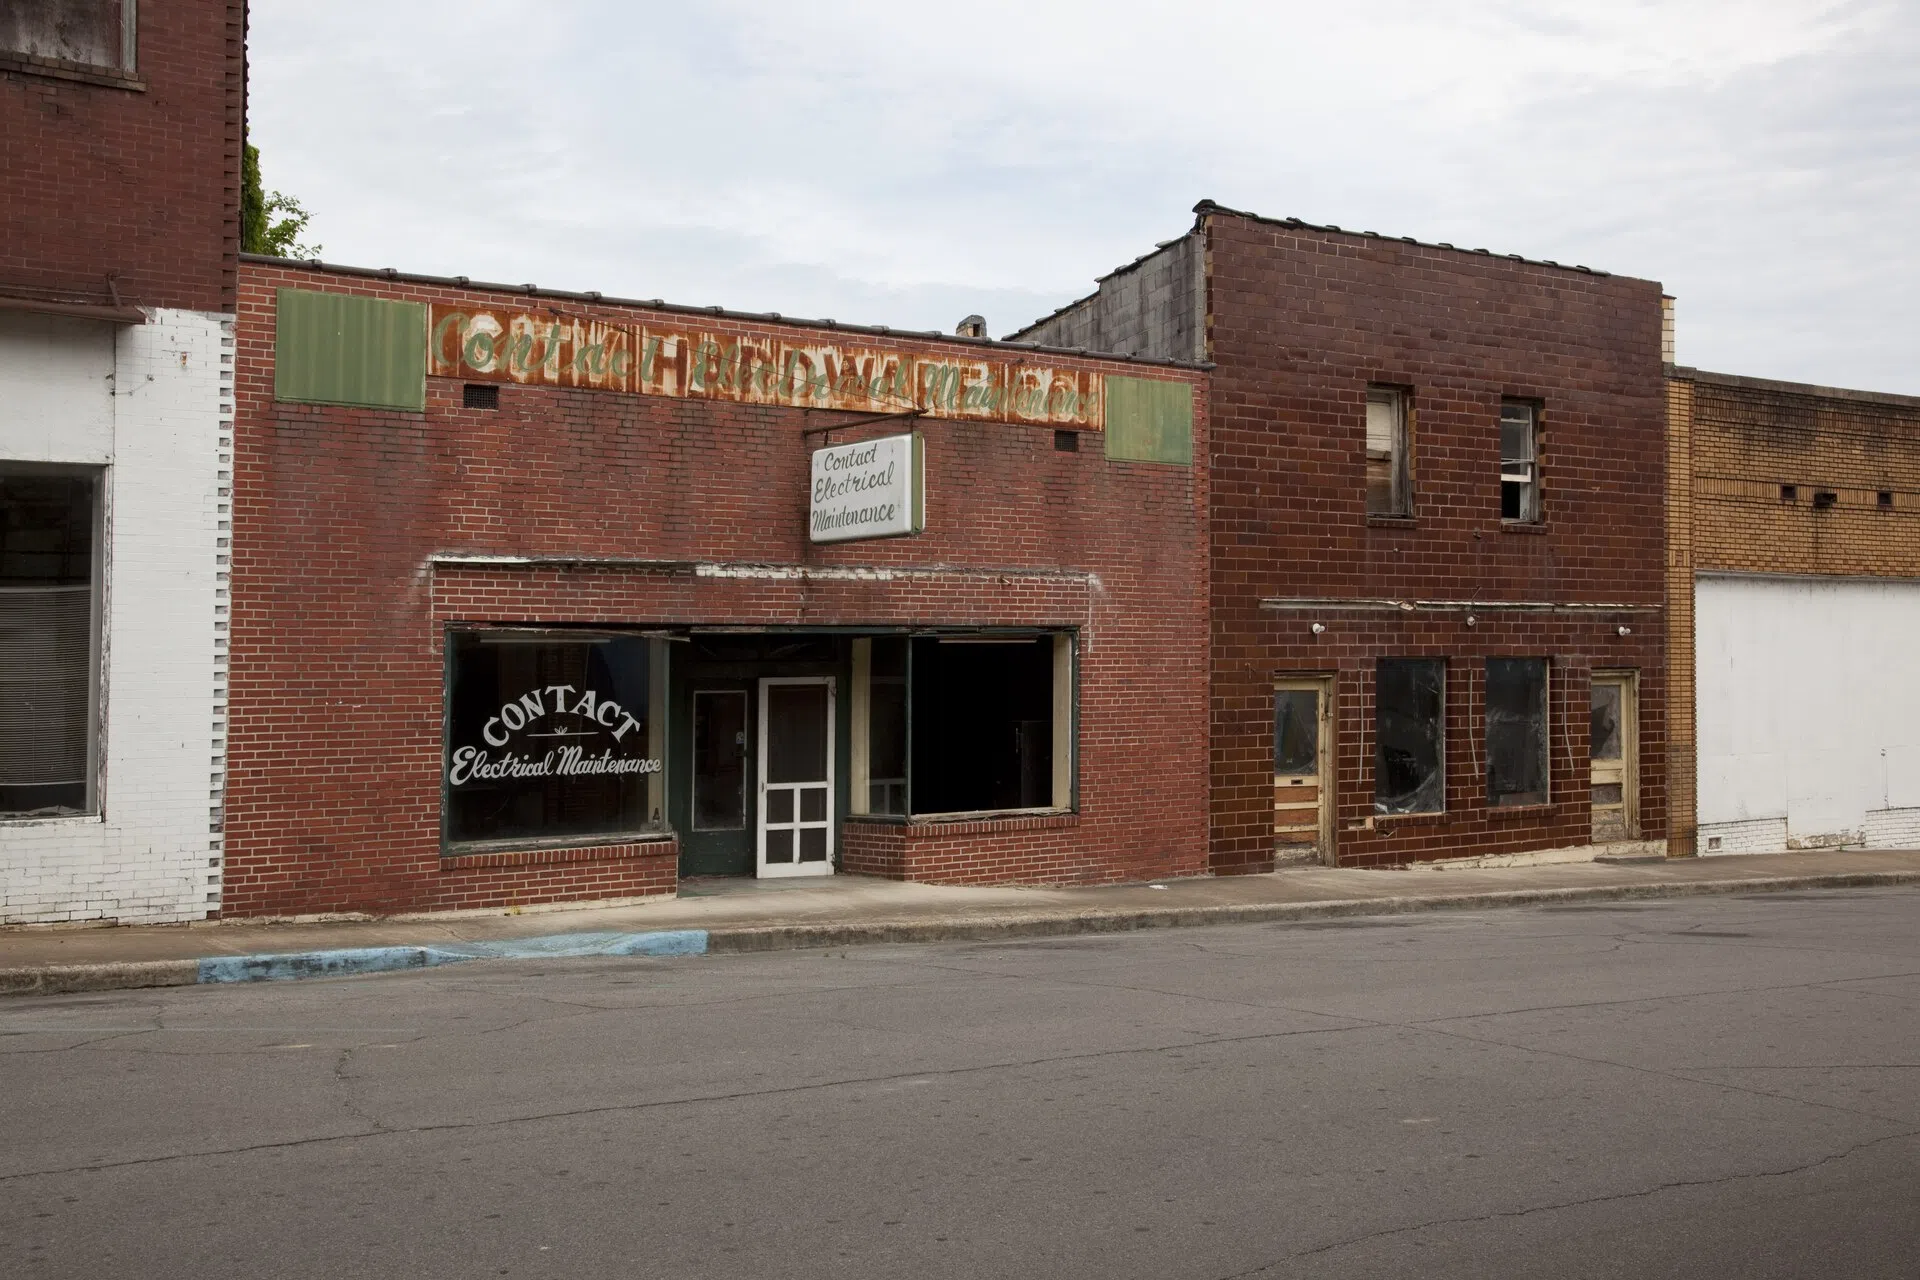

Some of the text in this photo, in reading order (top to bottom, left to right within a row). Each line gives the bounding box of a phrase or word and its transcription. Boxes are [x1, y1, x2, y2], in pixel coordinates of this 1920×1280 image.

[431, 312, 658, 382] Contact
[824, 443, 877, 471] Contact
[814, 461, 895, 503] Electrical
[812, 503, 895, 532] Maintenance
[483, 684, 641, 747] CONTACT
[450, 745, 662, 786] Electrical Maintenance
